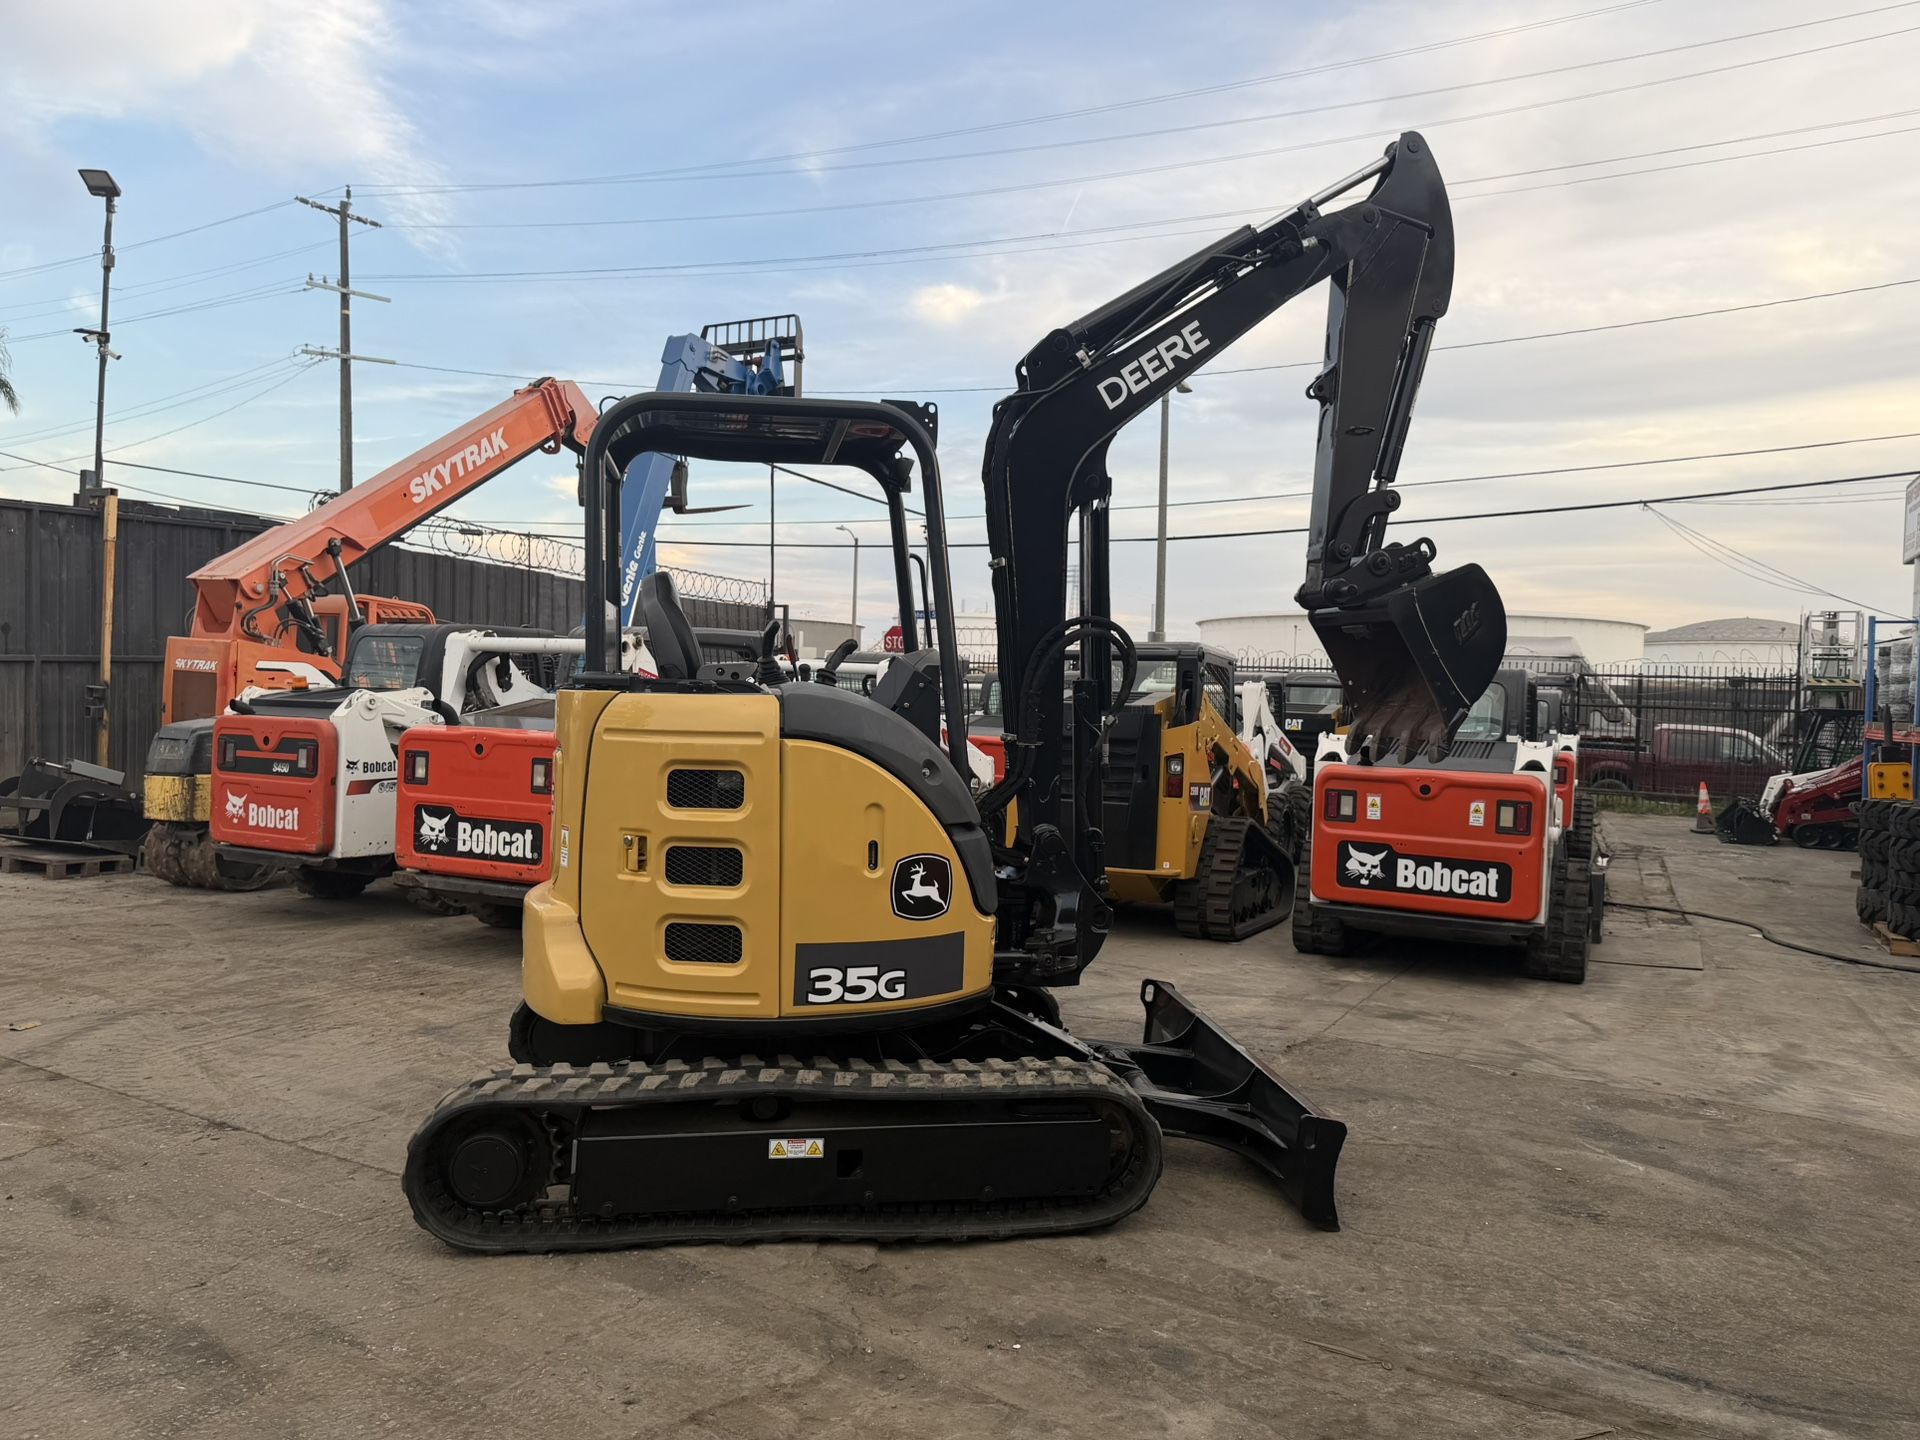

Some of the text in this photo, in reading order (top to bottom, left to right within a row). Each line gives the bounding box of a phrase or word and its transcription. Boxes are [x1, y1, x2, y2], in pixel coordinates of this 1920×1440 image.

[1096, 320, 1211, 411] DEERE
[409, 426, 509, 504] SKYTRAK
[634, 530, 647, 559] Genie
[885, 635, 904, 649] STO
[175, 658, 218, 671] SKYTRAK
[1284, 718, 1303, 731] CAT
[272, 762, 290, 773] S450
[363, 760, 396, 774] Bobcat
[1199, 786, 1211, 807] CAT
[248, 802, 299, 831] Bobcat
[457, 821, 533, 859] Bobcat
[1396, 858, 1499, 898] Bobcat
[807, 966, 905, 1004] 35G
